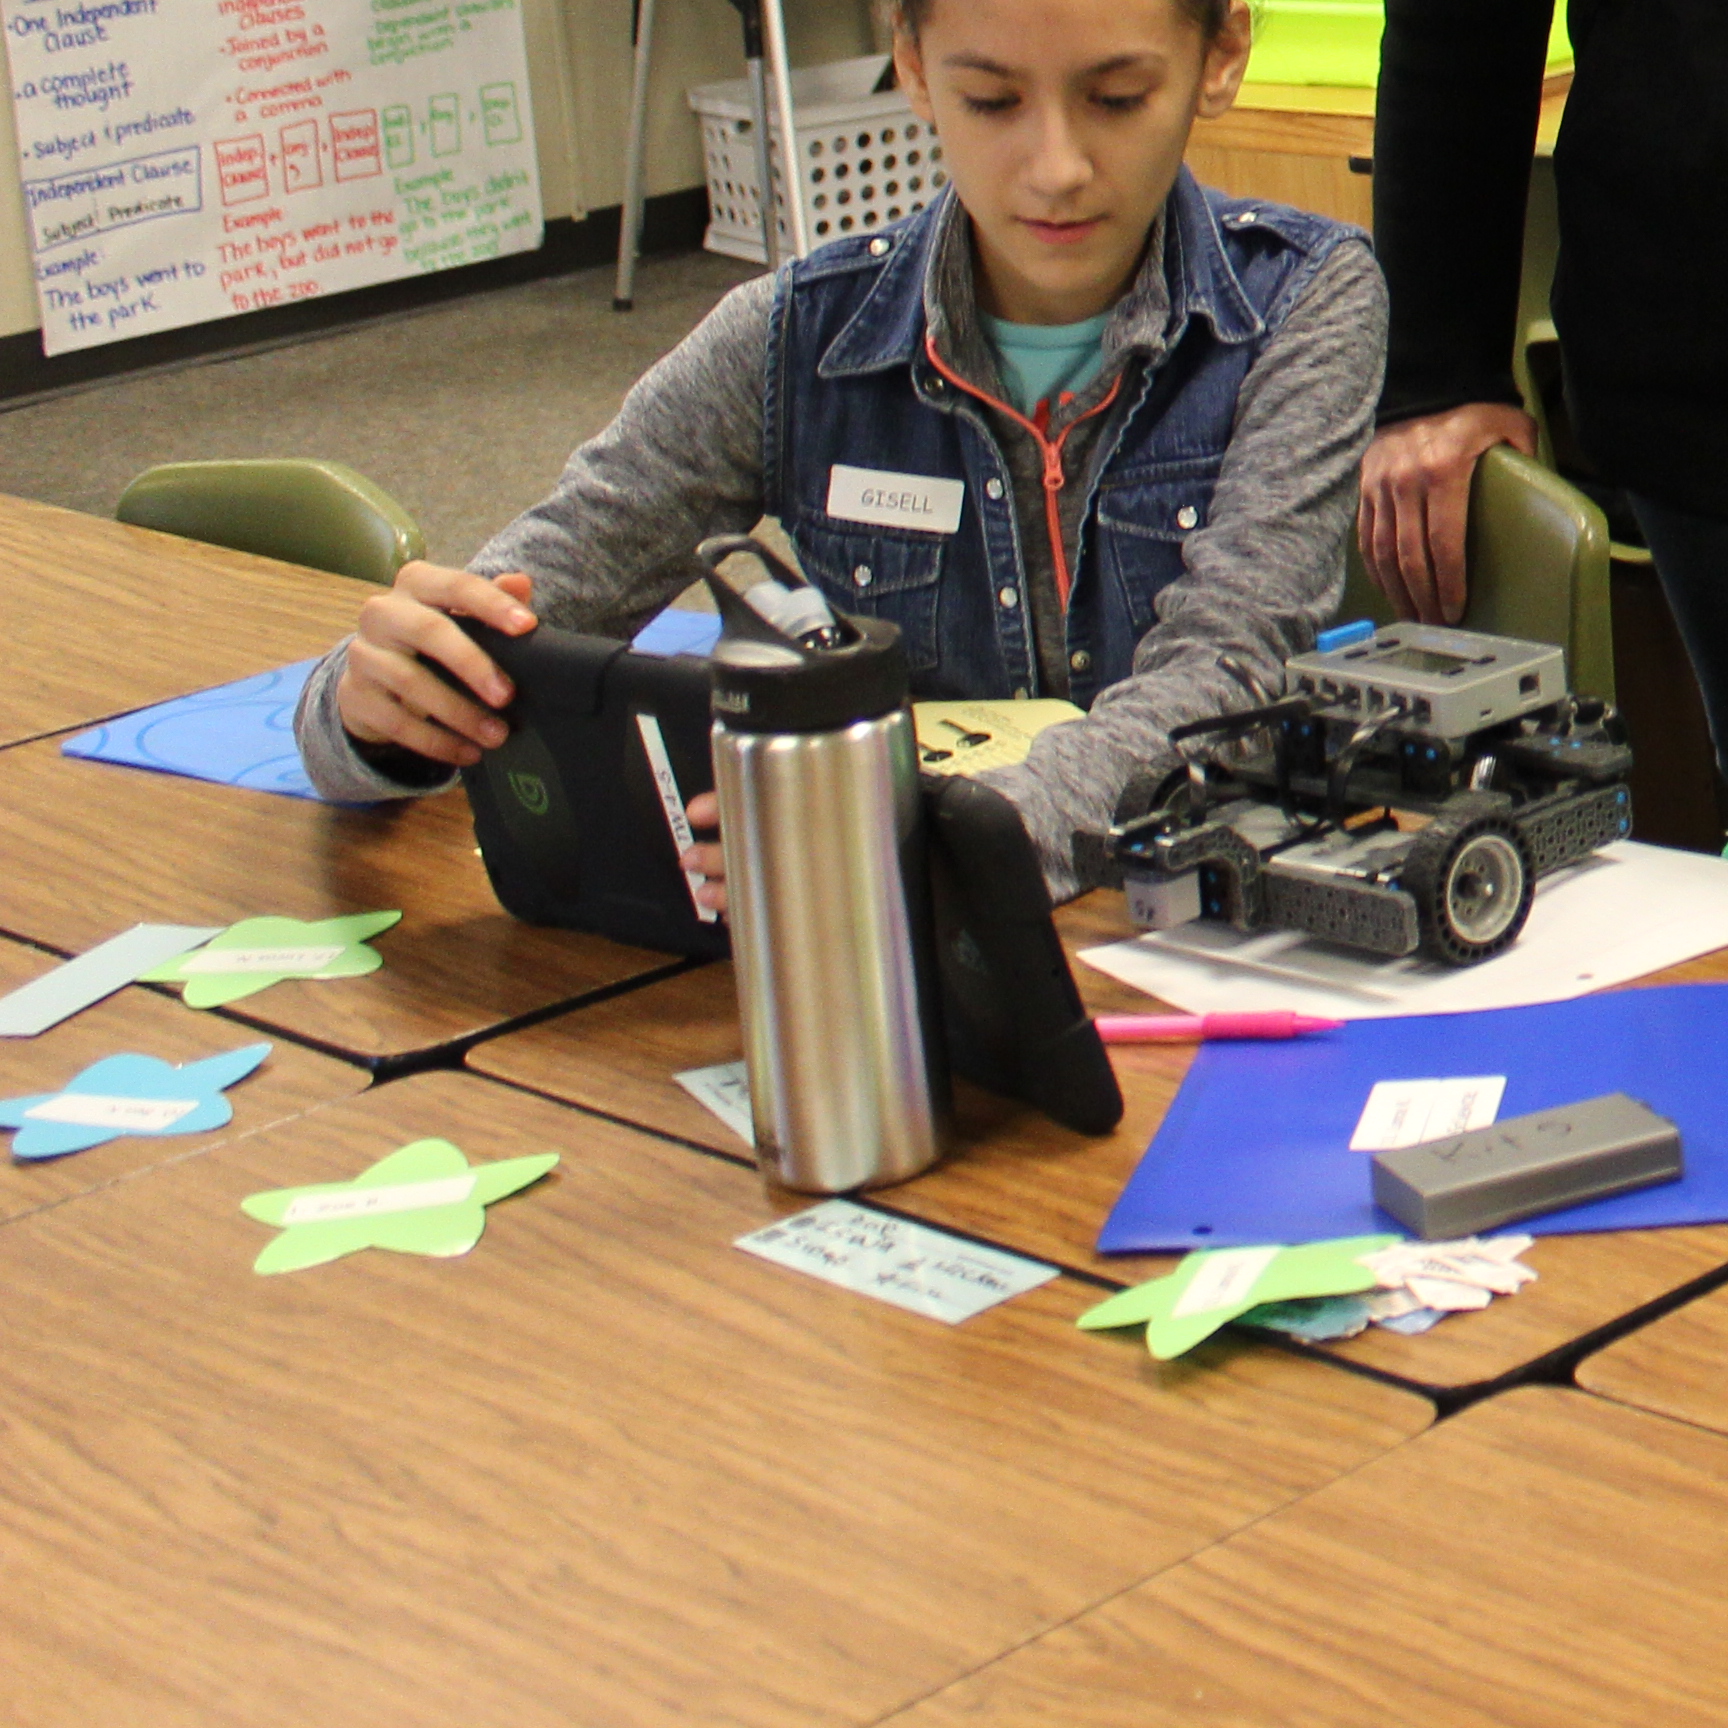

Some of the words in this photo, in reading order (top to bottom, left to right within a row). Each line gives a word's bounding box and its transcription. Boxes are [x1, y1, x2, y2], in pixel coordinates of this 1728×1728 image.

[13, 13, 48, 37] One
[45, 24, 110, 54] Clause
[23, 81, 38, 100] a
[40, 61, 130, 97] complete
[53, 80, 133, 113] thought
[32, 130, 97, 162] Subject
[115, 105, 197, 147] predicate
[130, 158, 196, 185] Clause
[44, 287, 84, 311] The
[86, 276, 131, 301] boys
[183, 260, 207, 279] to
[69, 308, 103, 332] the
[861, 487, 934, 515] GISELL
